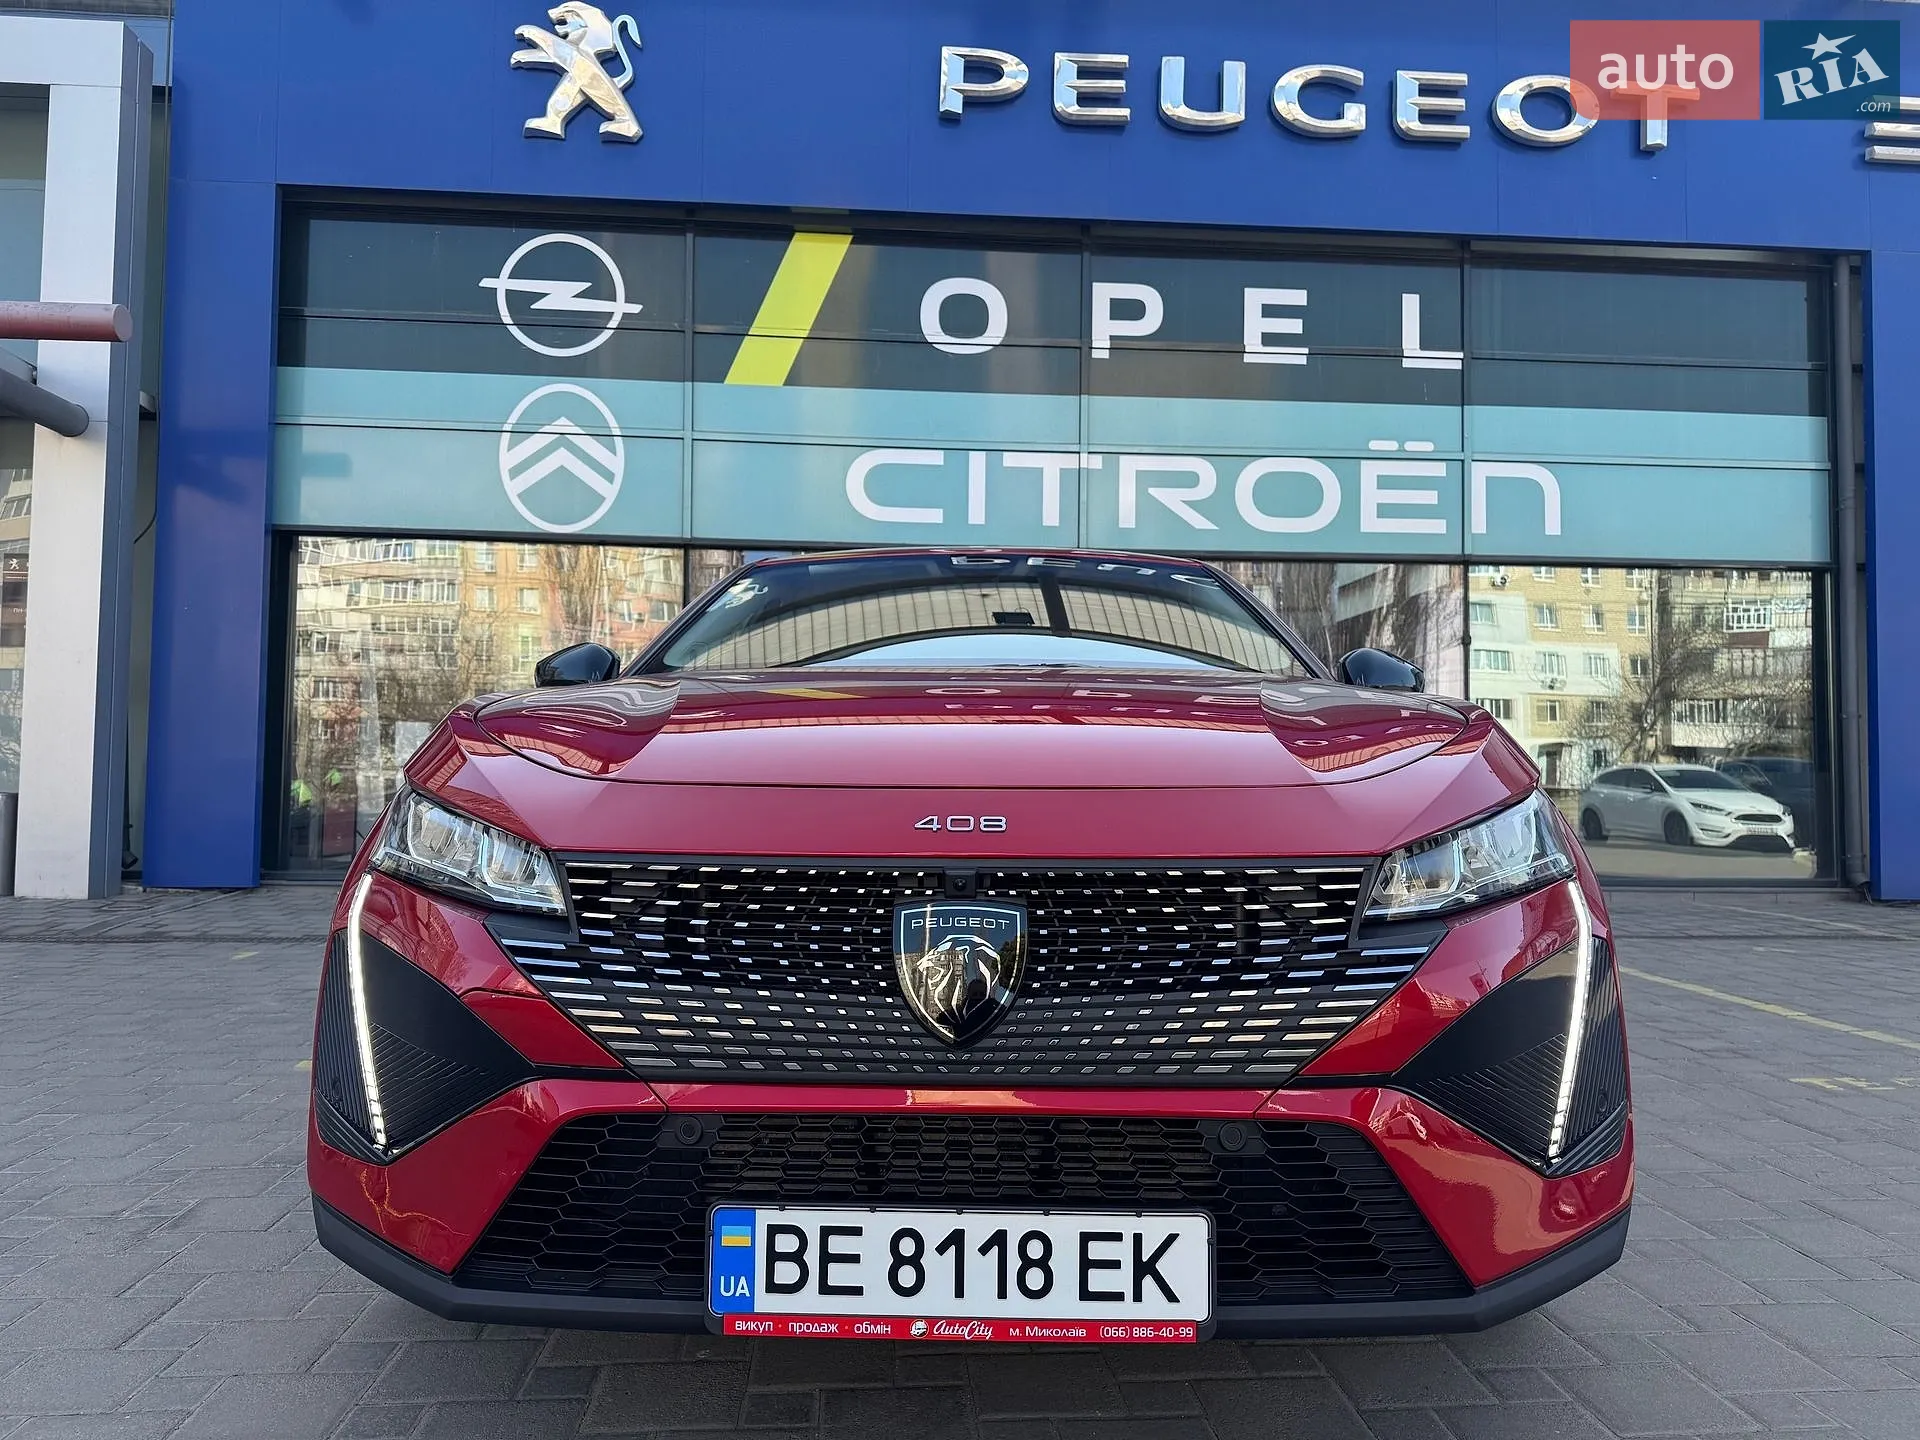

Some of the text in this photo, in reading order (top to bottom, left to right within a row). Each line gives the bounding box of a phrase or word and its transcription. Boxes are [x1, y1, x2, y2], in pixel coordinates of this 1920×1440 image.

[938, 45, 1700, 152] PEUGEOT
[919, 276, 1464, 370] OPEL
[913, 814, 1008, 833] 408
[911, 917, 1010, 930] PEUGEOT
[764, 1223, 1181, 1304] BE 8118 EK
[720, 1275, 750, 1298] UA
[735, 1320, 891, 1335] викуп продаж обмін
[933, 1320, 993, 1340] AutoCity
[1009, 1326, 1086, 1337] м. Миколаїв
[1099, 1327, 1193, 1338] (066) 886-40-99
